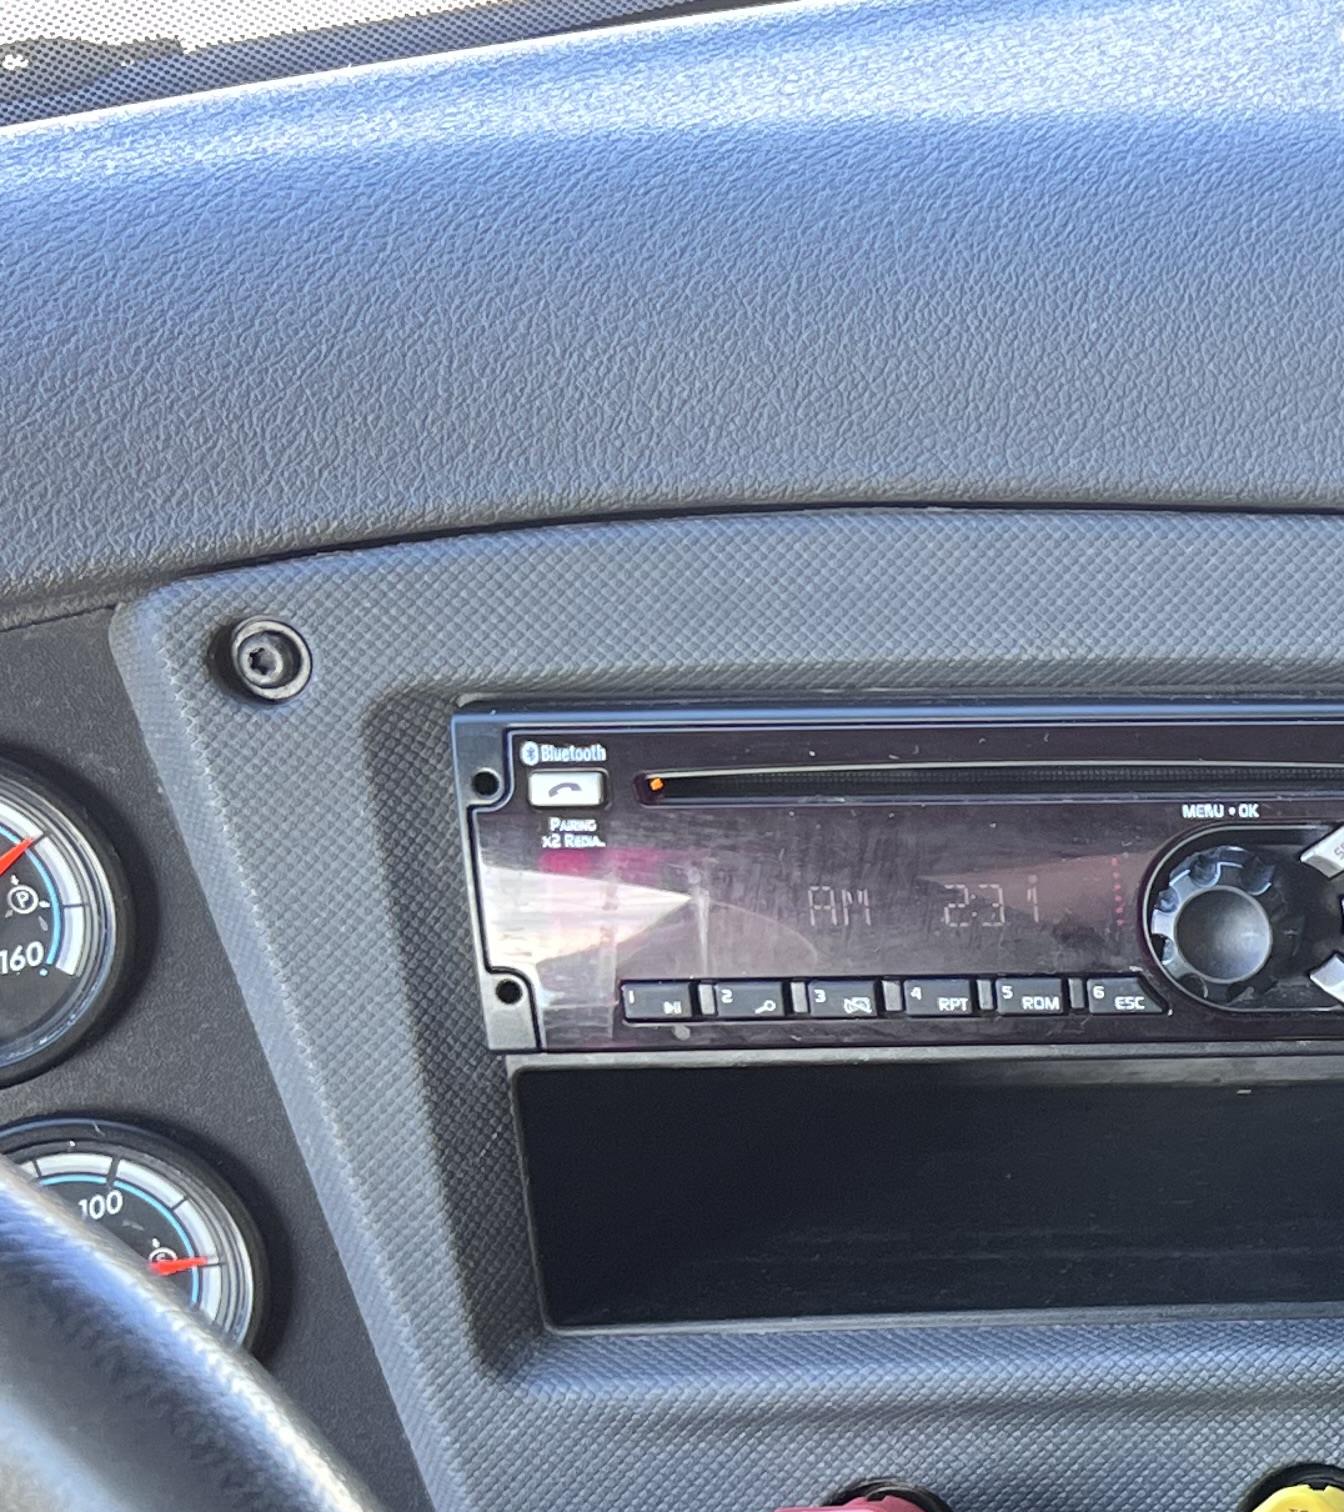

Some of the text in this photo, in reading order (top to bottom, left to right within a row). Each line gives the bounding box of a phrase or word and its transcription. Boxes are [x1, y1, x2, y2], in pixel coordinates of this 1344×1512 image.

[541, 743, 606, 761] Bluetooth
[1183, 804, 1259, 818] MENU OK
[807, 885, 872, 926] AM
[0, 941, 44, 974] 160
[721, 989, 733, 1003] 2
[815, 989, 826, 1003] 3
[910, 986, 922, 1000] 4
[1002, 985, 1013, 999] 5
[1093, 986, 1105, 999] 6
[937, 998, 968, 1011] RPT
[1114, 996, 1145, 1010] ESC
[78, 1187, 123, 1221] 100
